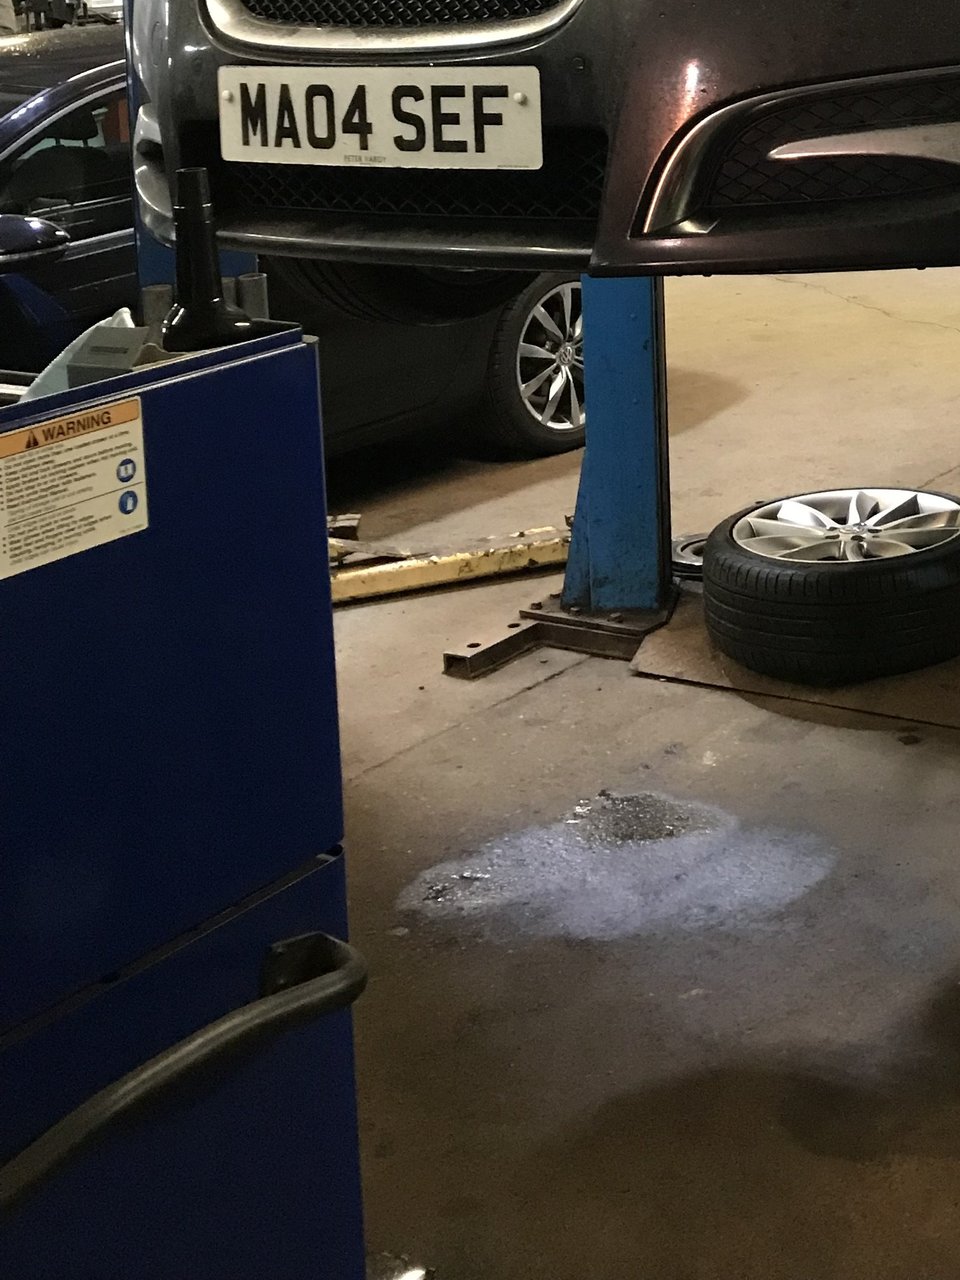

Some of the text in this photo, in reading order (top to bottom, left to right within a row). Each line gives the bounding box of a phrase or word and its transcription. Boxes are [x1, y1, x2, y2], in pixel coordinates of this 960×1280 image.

[239, 82, 509, 153] MA04 SEF
[42, 411, 112, 441] WARNING
